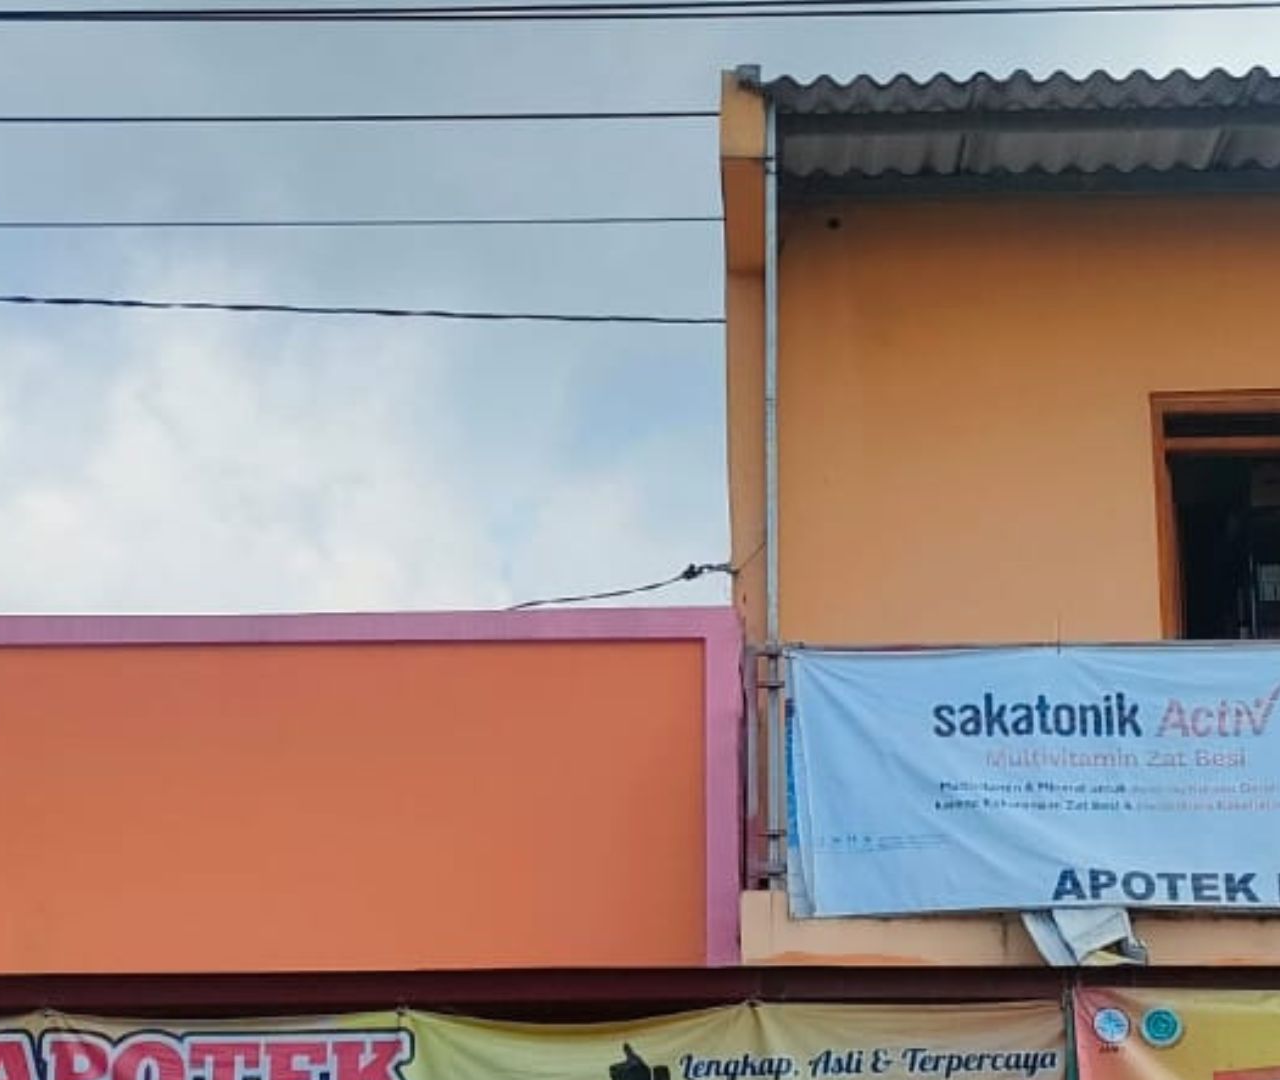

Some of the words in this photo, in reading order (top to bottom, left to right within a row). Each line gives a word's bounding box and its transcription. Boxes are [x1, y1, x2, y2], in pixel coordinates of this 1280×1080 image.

[932, 693, 1143, 737] sakatonik
[986, 748, 1138, 768] Multivitamin
[1147, 750, 1185, 768] Zat
[1196, 749, 1246, 768] Besi
[1052, 868, 1258, 902] APOTEK
[808, 1050, 863, 1078] Asli
[871, 1050, 892, 1074] &
[902, 1047, 1057, 1080] Terpercaya
